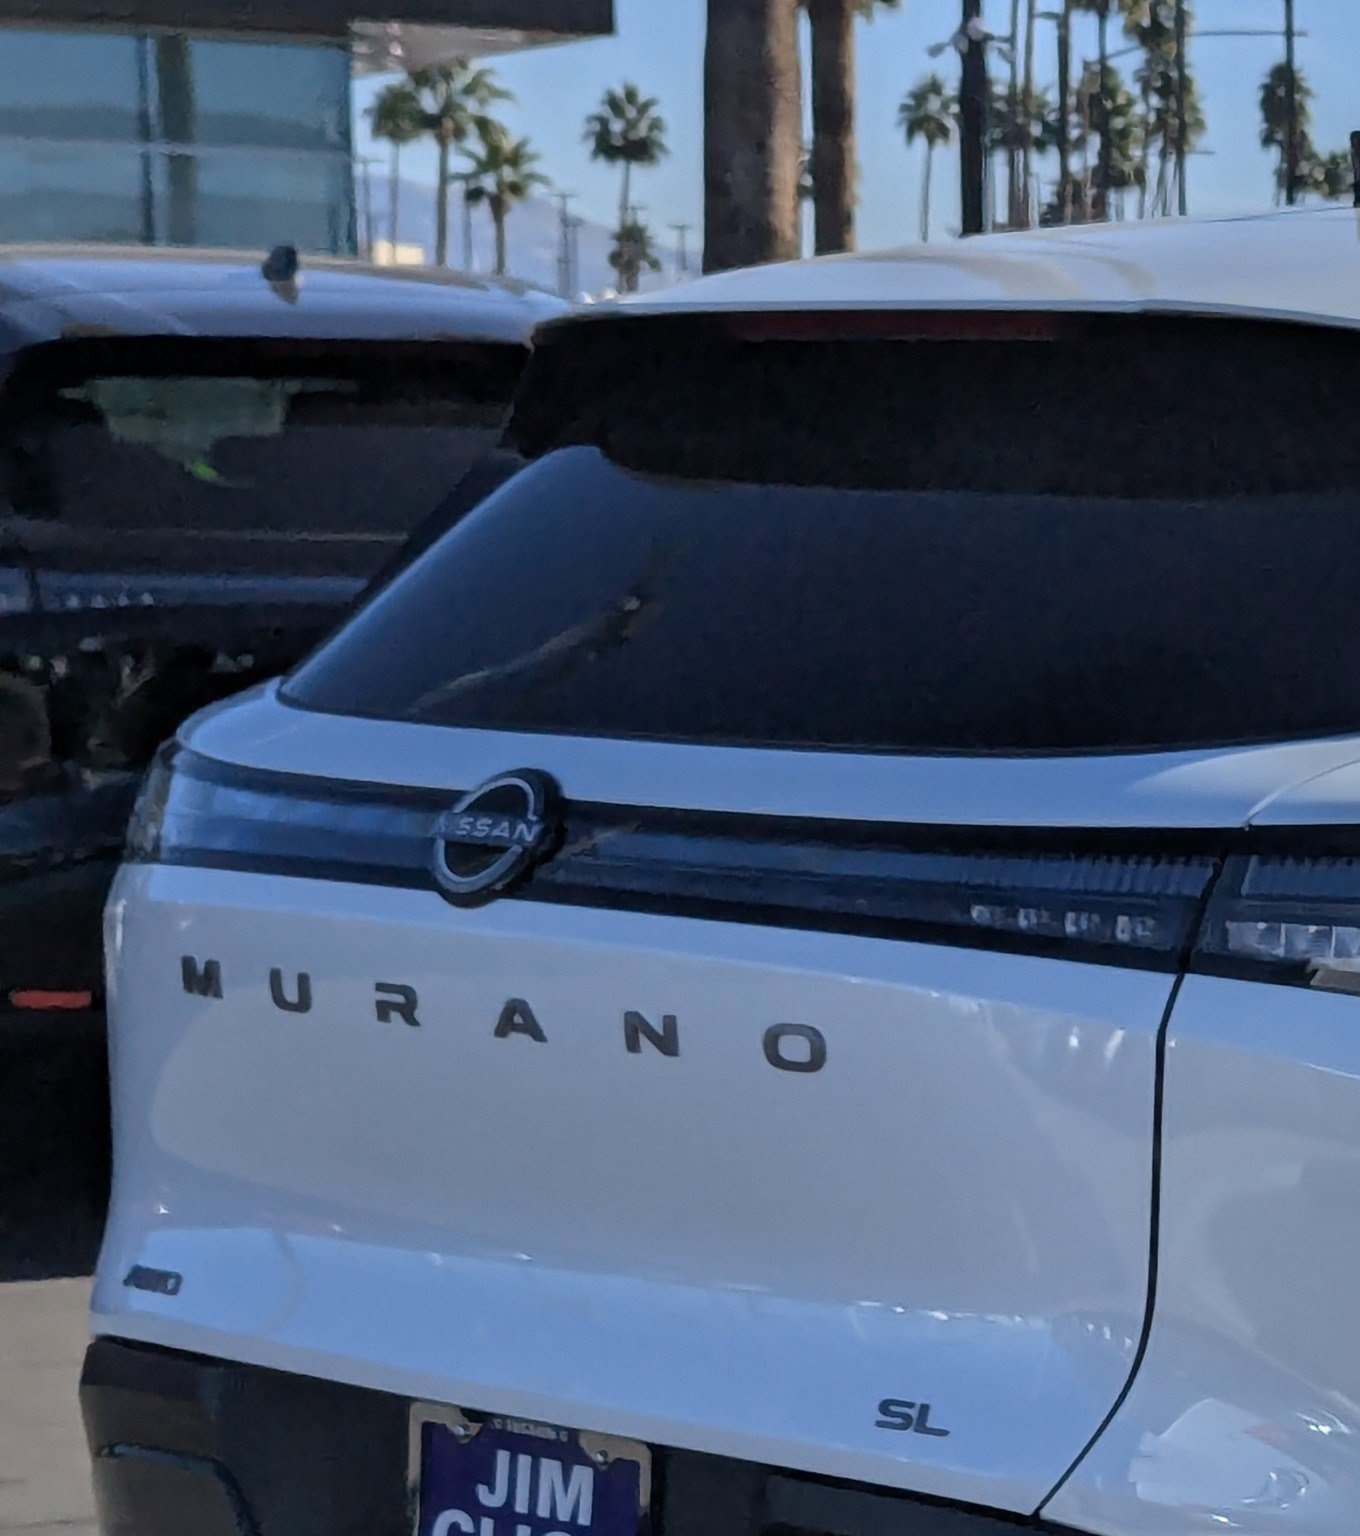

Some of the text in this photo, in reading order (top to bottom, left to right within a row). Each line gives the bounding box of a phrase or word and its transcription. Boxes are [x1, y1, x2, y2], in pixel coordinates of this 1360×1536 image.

[429, 811, 543, 842] NSSAN
[182, 954, 828, 1073] MURANO
[875, 1398, 951, 1437] SL
[475, 1449, 594, 1526] JIM
